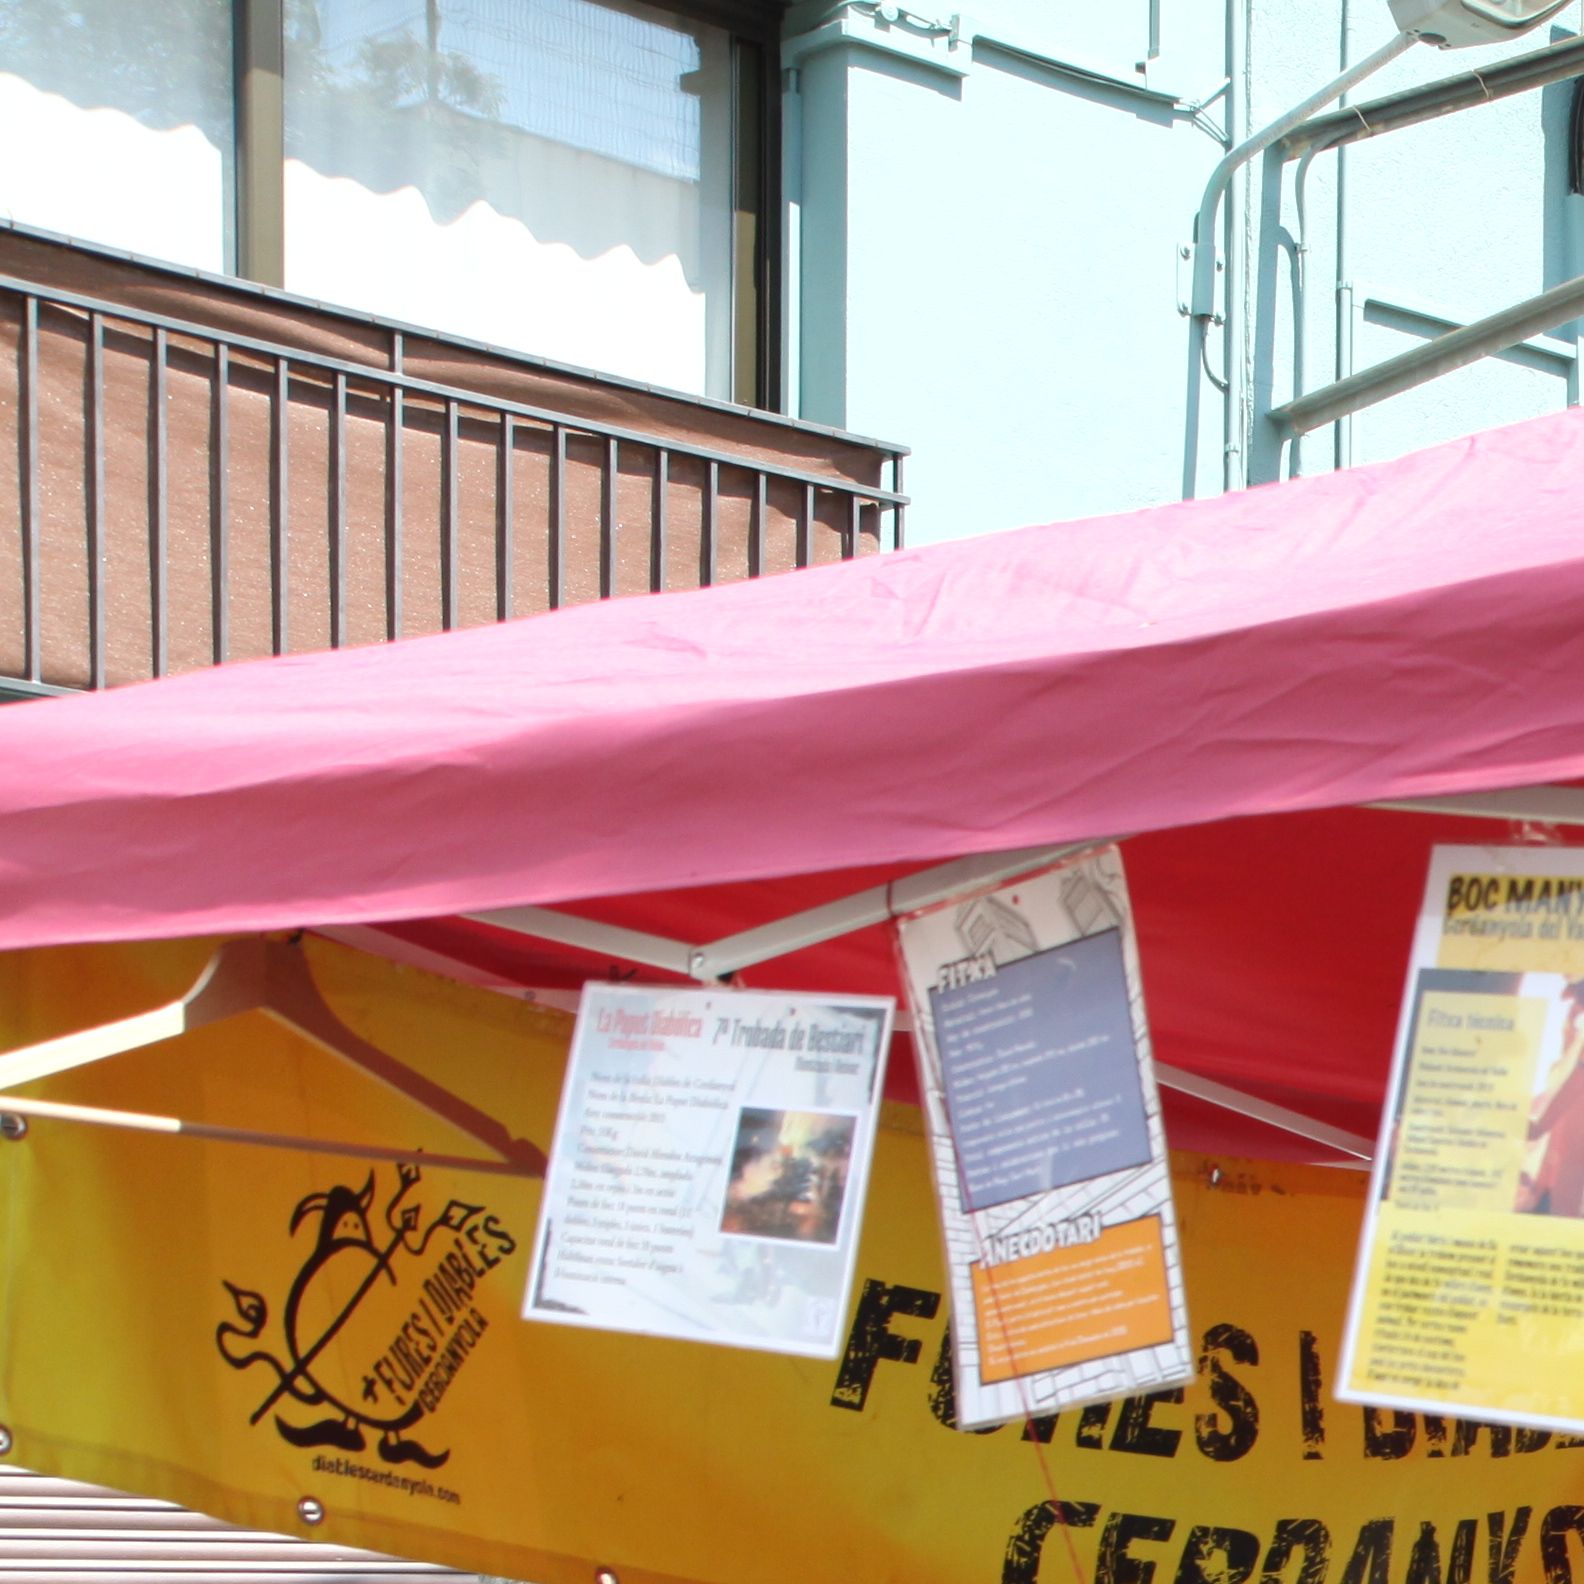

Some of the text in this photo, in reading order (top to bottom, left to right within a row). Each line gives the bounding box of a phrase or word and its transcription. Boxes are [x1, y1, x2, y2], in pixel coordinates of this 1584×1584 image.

[1447, 876, 1499, 915] BOC
[426, 1214, 517, 1326] DIABLES
[419, 1307, 489, 1414] CERDANYOLA
